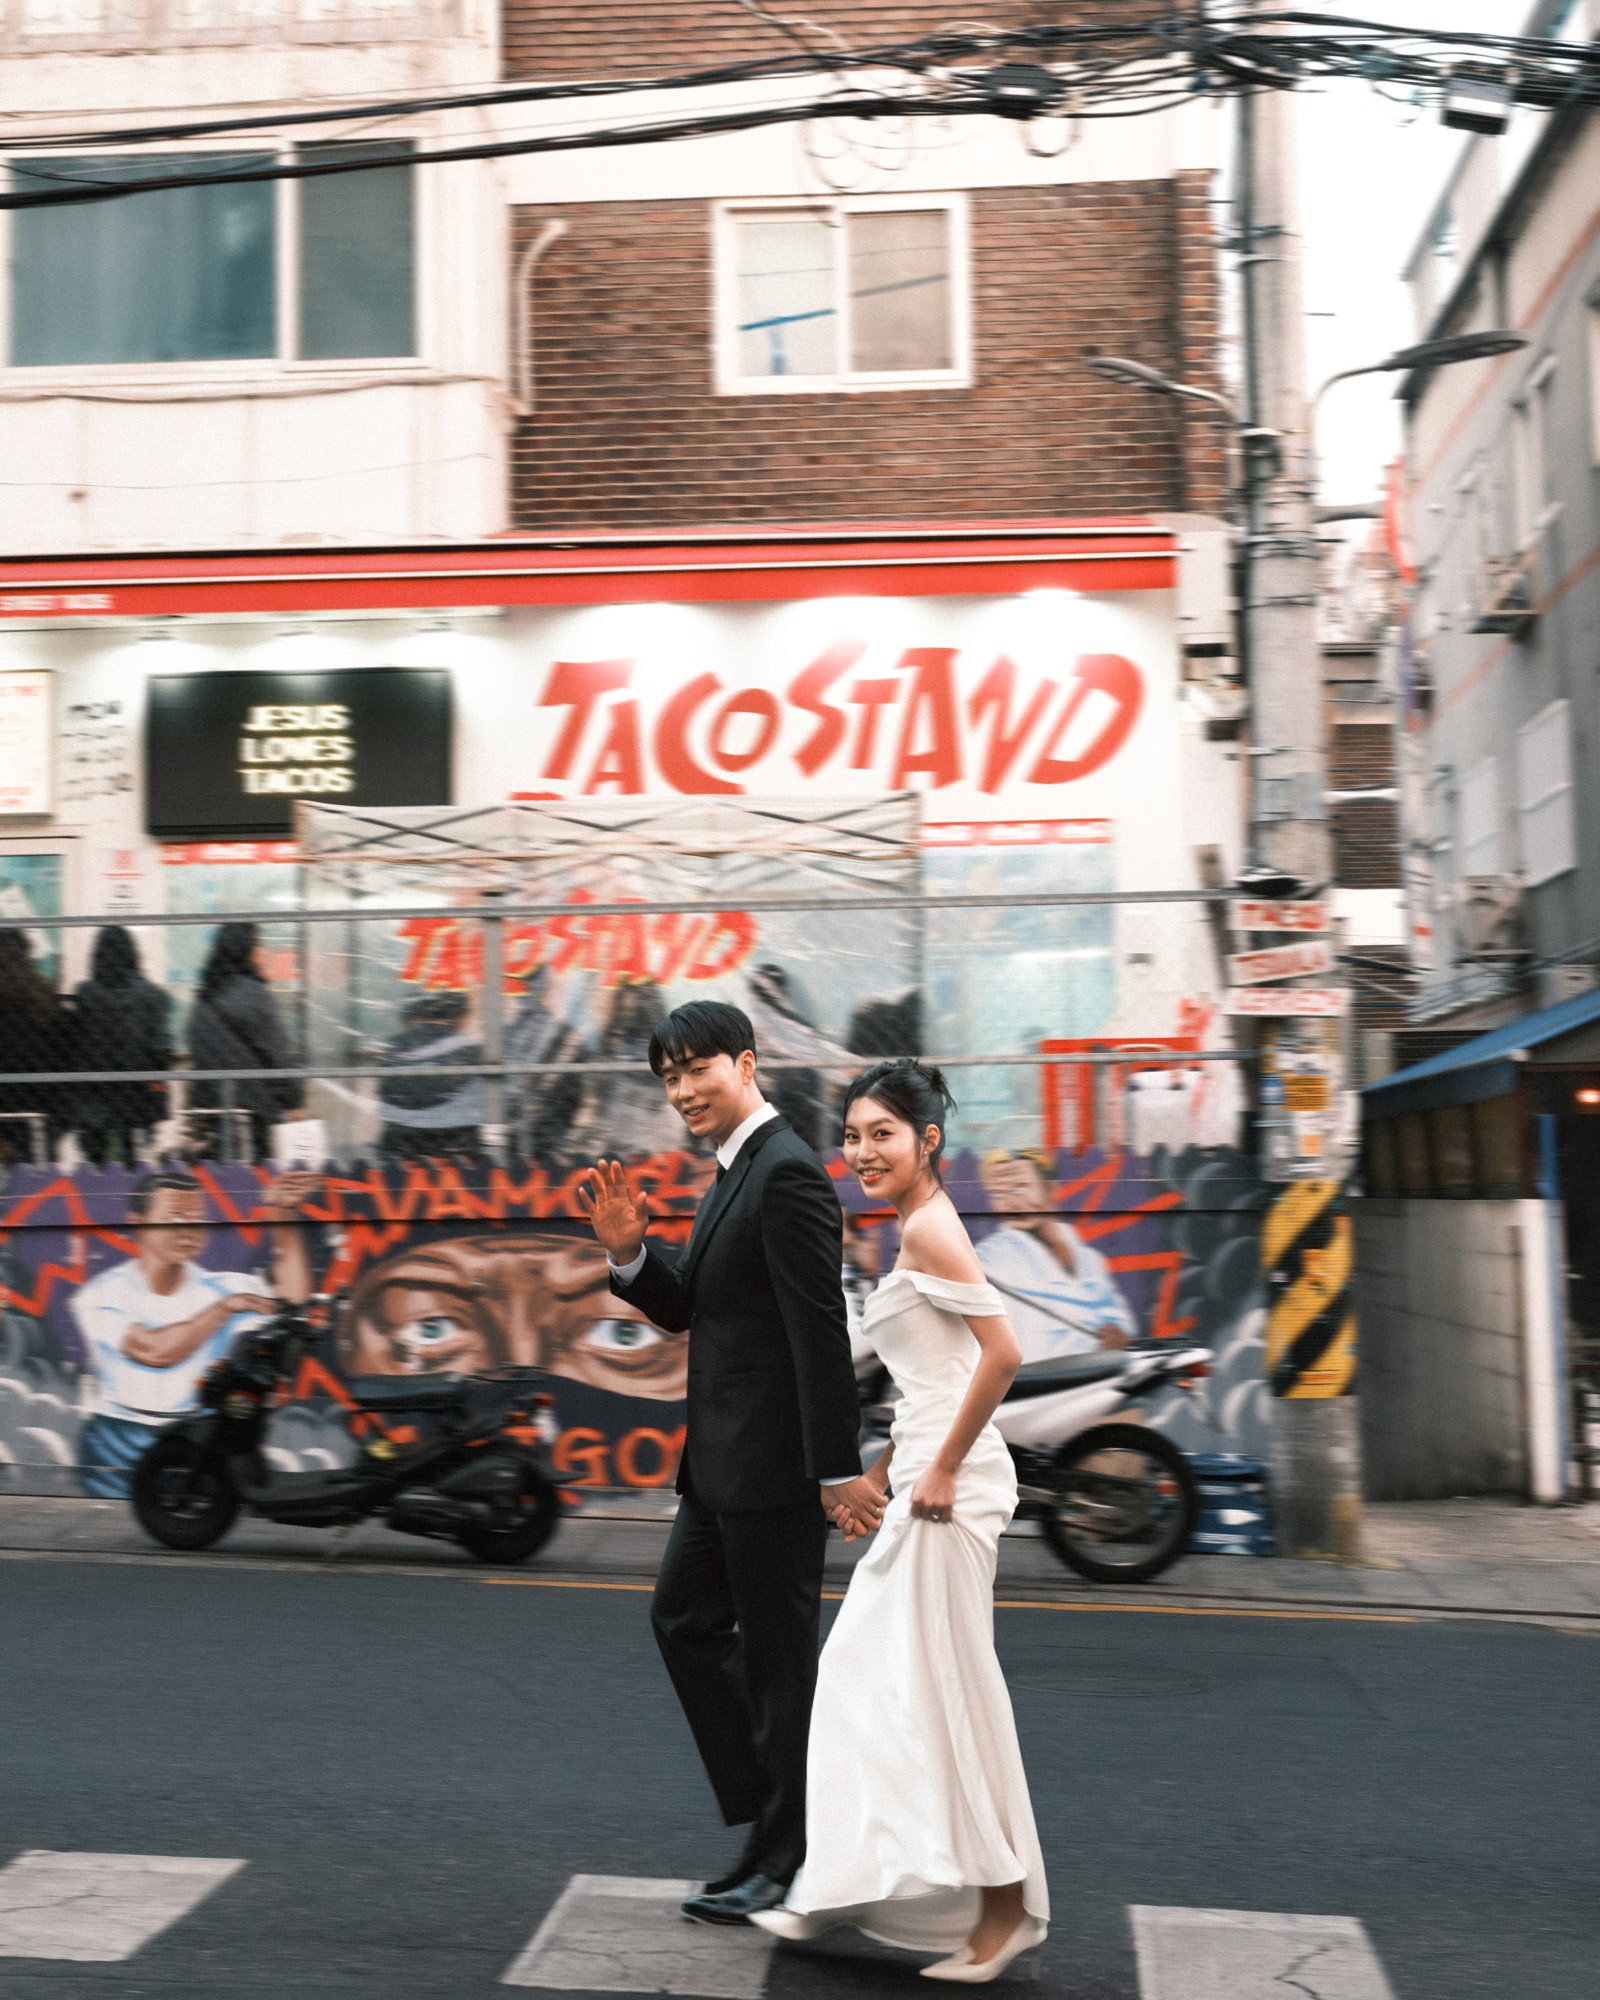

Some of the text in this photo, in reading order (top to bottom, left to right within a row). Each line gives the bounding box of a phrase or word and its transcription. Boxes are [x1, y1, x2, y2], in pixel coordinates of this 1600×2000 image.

[243, 705, 352, 730] JESUS
[239, 737, 355, 762] LOVES
[236, 768, 355, 793] TACOS
